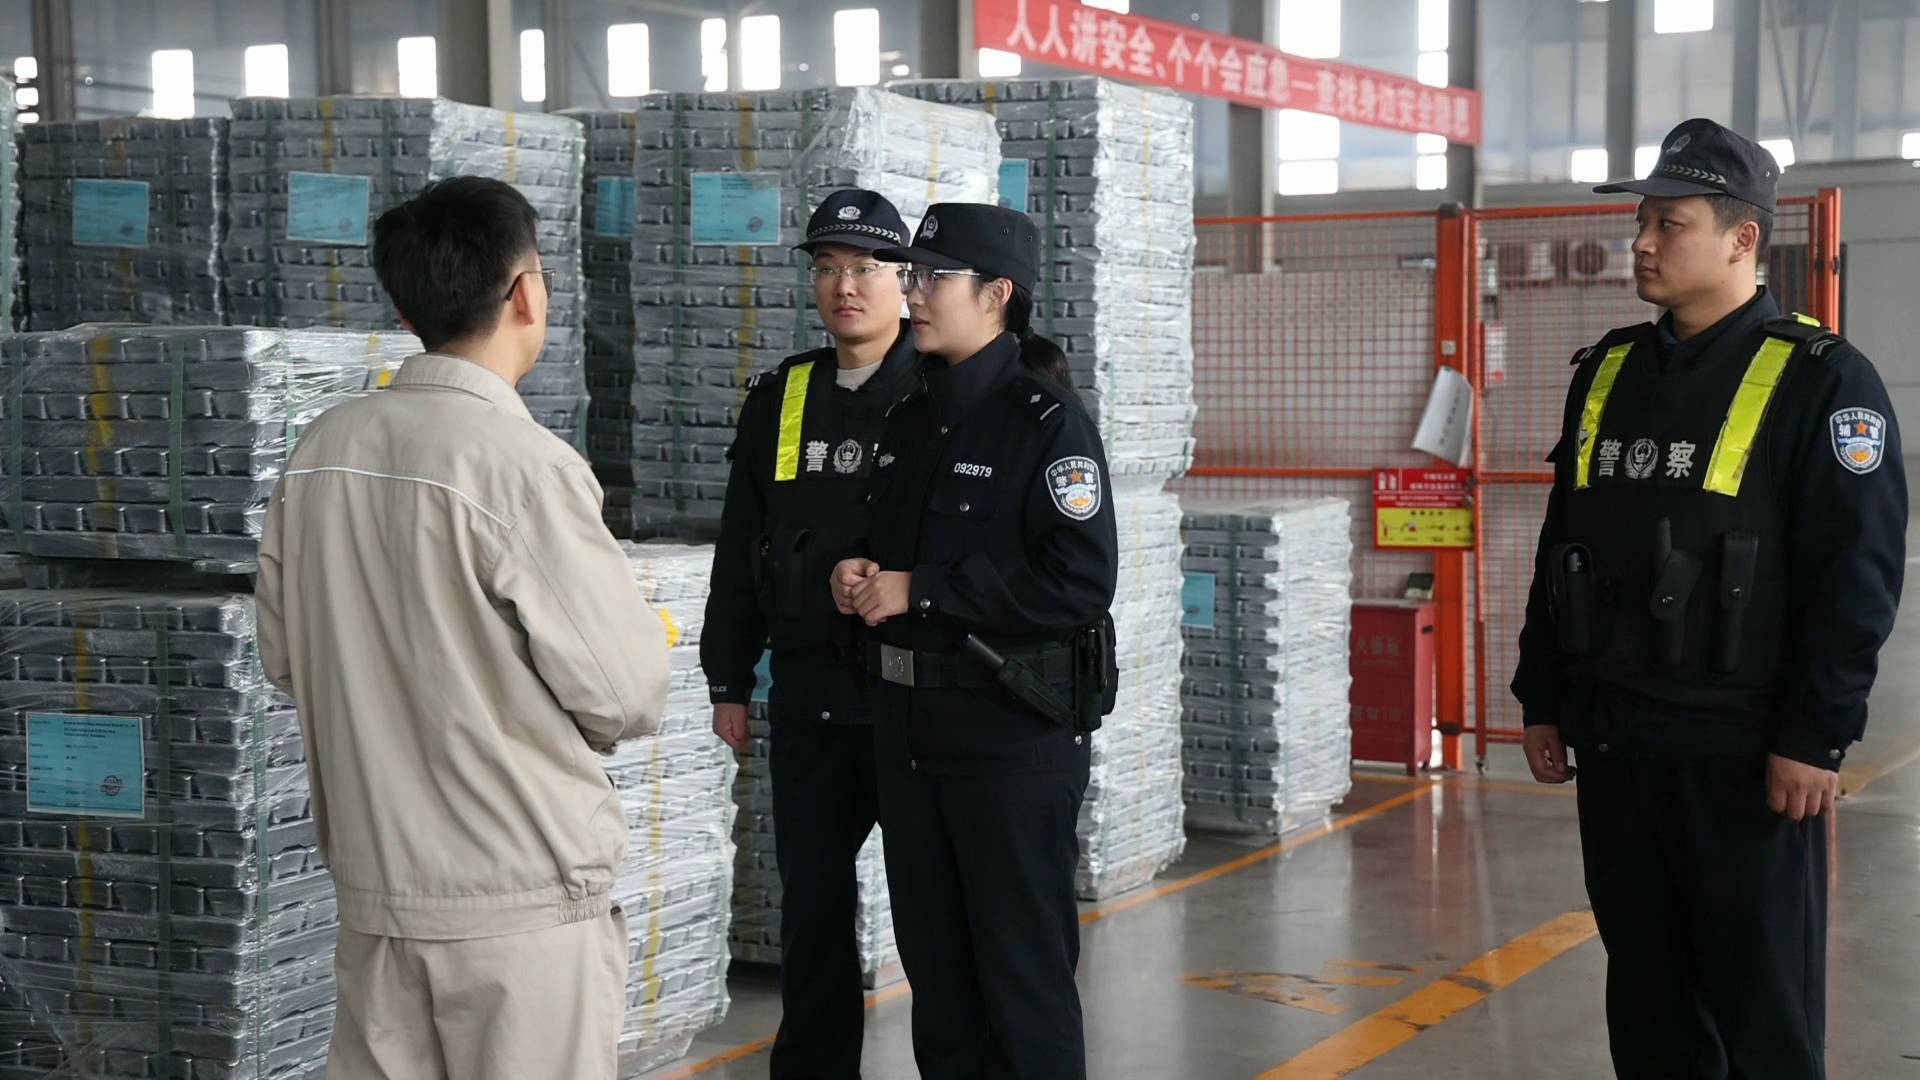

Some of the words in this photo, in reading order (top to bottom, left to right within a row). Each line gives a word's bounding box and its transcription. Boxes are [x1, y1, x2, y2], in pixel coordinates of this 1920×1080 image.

[1835, 411, 1882, 429] 中华人民共和国
[805, 440, 829, 473] 警
[1598, 439, 1623, 477] 警
[1665, 440, 1696, 478] 察
[953, 462, 993, 479] 092979
[1050, 460, 1095, 477] 中华人民共和国
